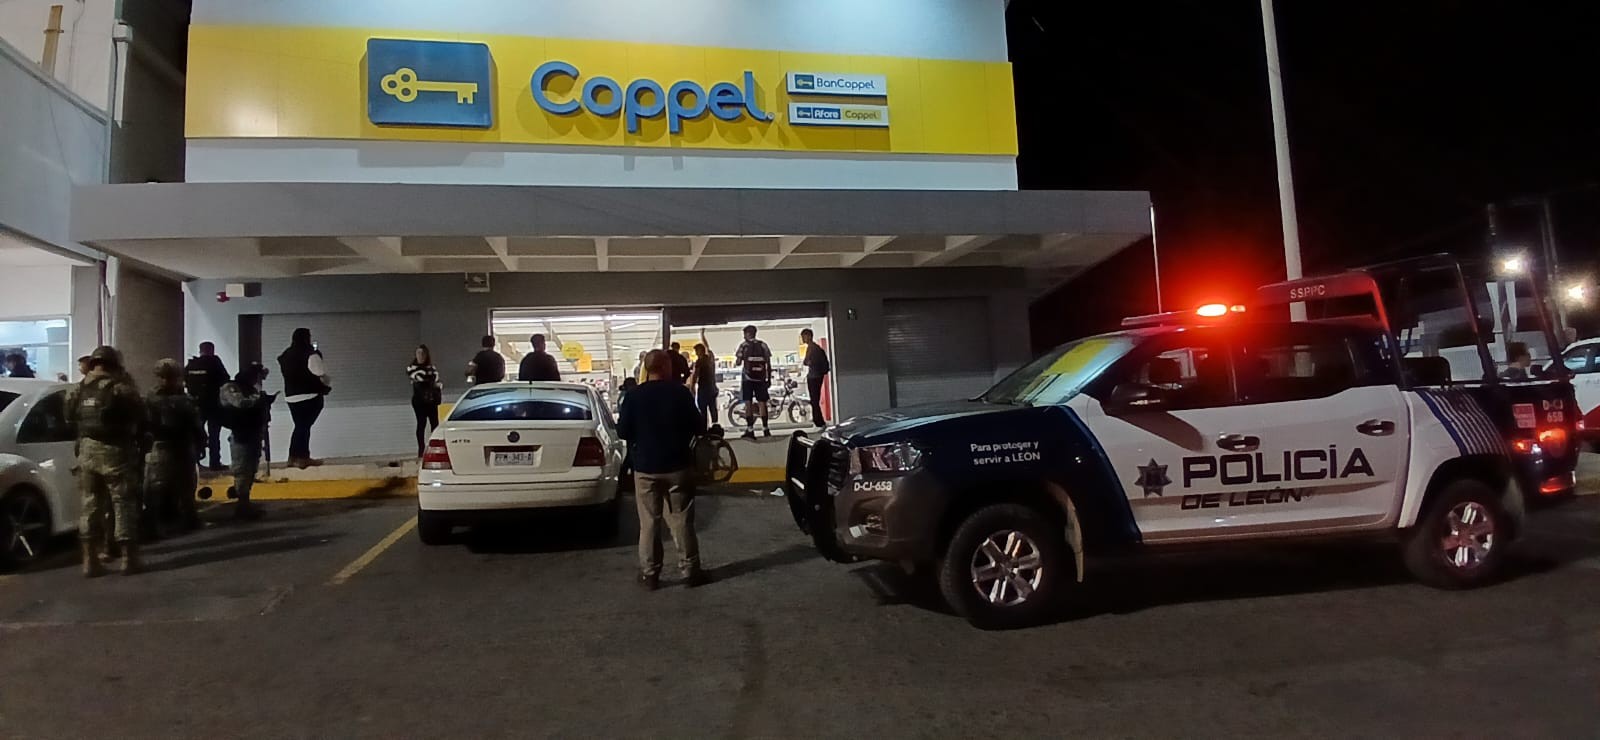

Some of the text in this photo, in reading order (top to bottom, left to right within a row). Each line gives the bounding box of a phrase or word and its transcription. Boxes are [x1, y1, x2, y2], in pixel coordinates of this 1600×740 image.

[816, 77, 875, 90] BanCoppel
[530, 60, 765, 132] Coppel
[814, 109, 878, 120] Afore Coppel
[970, 443, 992, 453] Para
[1033, 441, 1039, 450] y
[973, 455, 1002, 465] servir
[1182, 444, 1375, 488] POLICÍA
[1181, 486, 1303, 510] DE LEÓN
